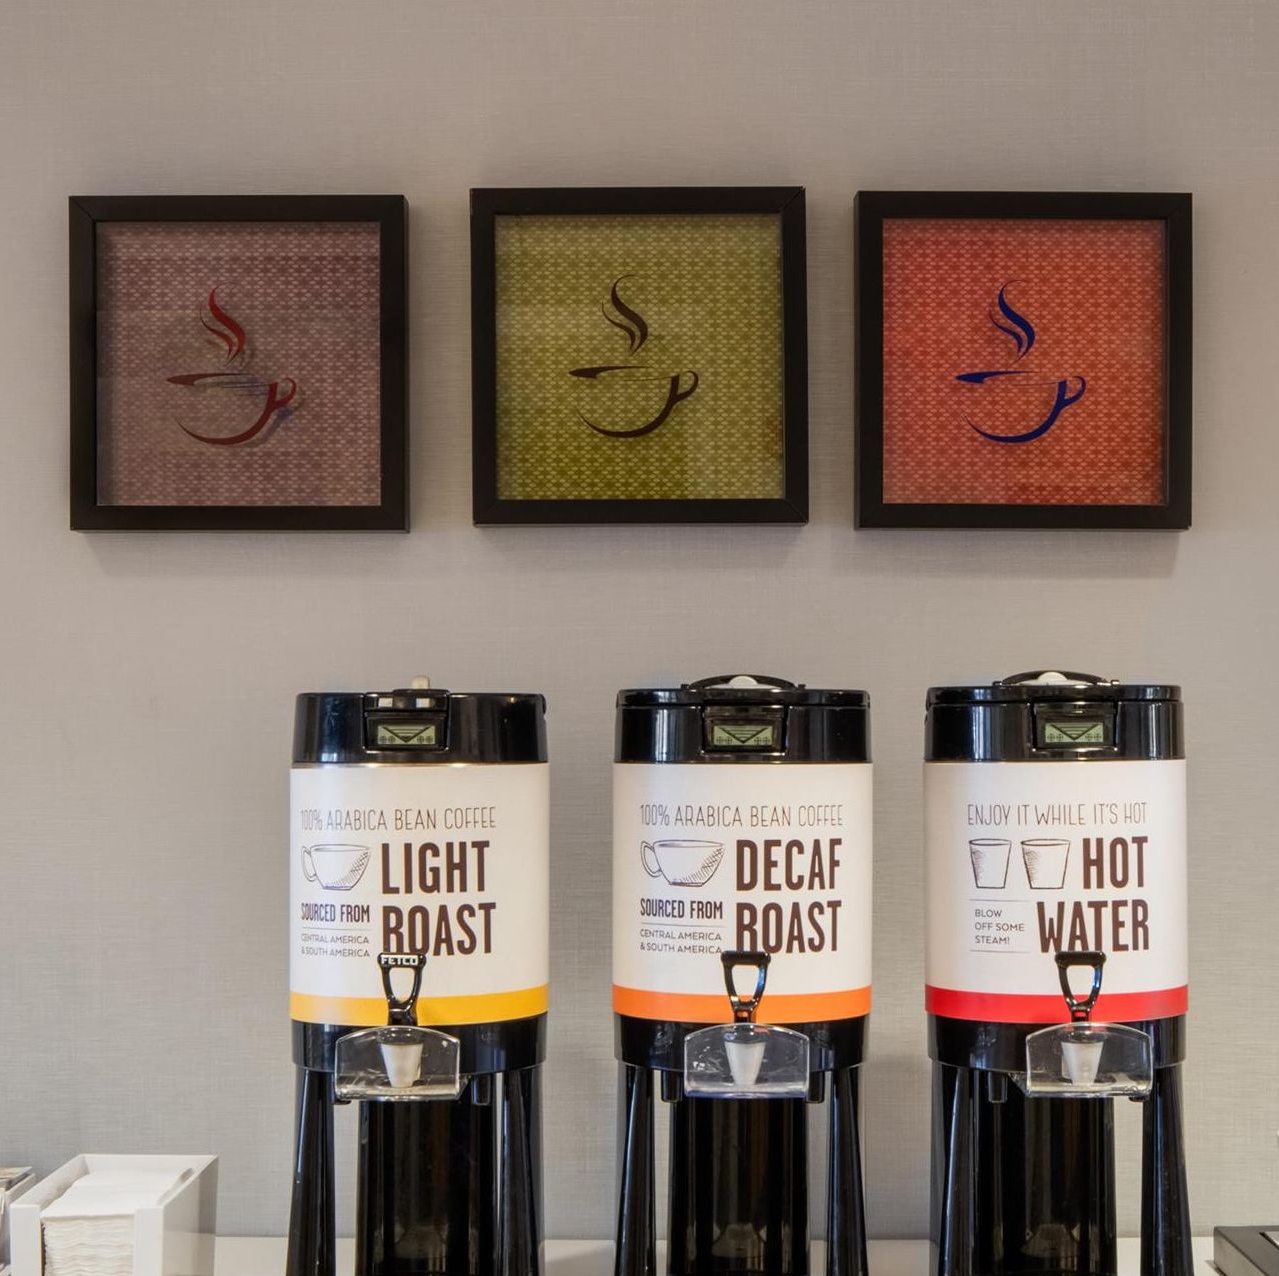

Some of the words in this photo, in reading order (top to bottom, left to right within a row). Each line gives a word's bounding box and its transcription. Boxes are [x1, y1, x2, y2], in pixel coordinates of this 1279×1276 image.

[300, 809, 323, 831] 100%
[326, 808, 388, 831] ARABICA
[394, 808, 437, 831] BEAN
[443, 806, 497, 830] COFFEE
[640, 804, 670, 827] 100%
[674, 805, 743, 828] ARABICA
[750, 805, 791, 828] BEAN
[798, 804, 843, 827] COFFEE
[967, 803, 1011, 826] ENJOY
[1017, 804, 1030, 826] IT
[1034, 803, 1087, 826] WHILE
[1093, 802, 1118, 825] IT'S
[1123, 801, 1147, 824] HOT
[381, 839, 491, 895] LIGHT
[735, 838, 843, 892] DECAF
[1082, 835, 1149, 890] HOT
[300, 902, 336, 923] SOURCED
[340, 904, 370, 924] FROM
[640, 898, 685, 919] SOURCED
[690, 899, 723, 920] FROM
[974, 908, 1003, 918] BLOW
[382, 902, 497, 957] ROAST
[639, 928, 677, 940] CENTRAL
[677, 930, 722, 941] AMERICA
[735, 899, 843, 954] ROAST
[974, 922, 993, 932] OFF
[995, 923, 1025, 932] SOME
[1036, 898, 1150, 954] WATER
[300, 932, 329, 944] CENTRAL
[330, 934, 370, 945] AMERICA
[639, 942, 646, 951] &
[646, 943, 675, 953] SOUTH
[677, 945, 722, 955] AMERICA
[974, 935, 1011, 945] STEAM!
[306, 946, 328, 956] SOUTH
[329, 947, 371, 958] AMERICA
[381, 954, 419, 967] FETCO
